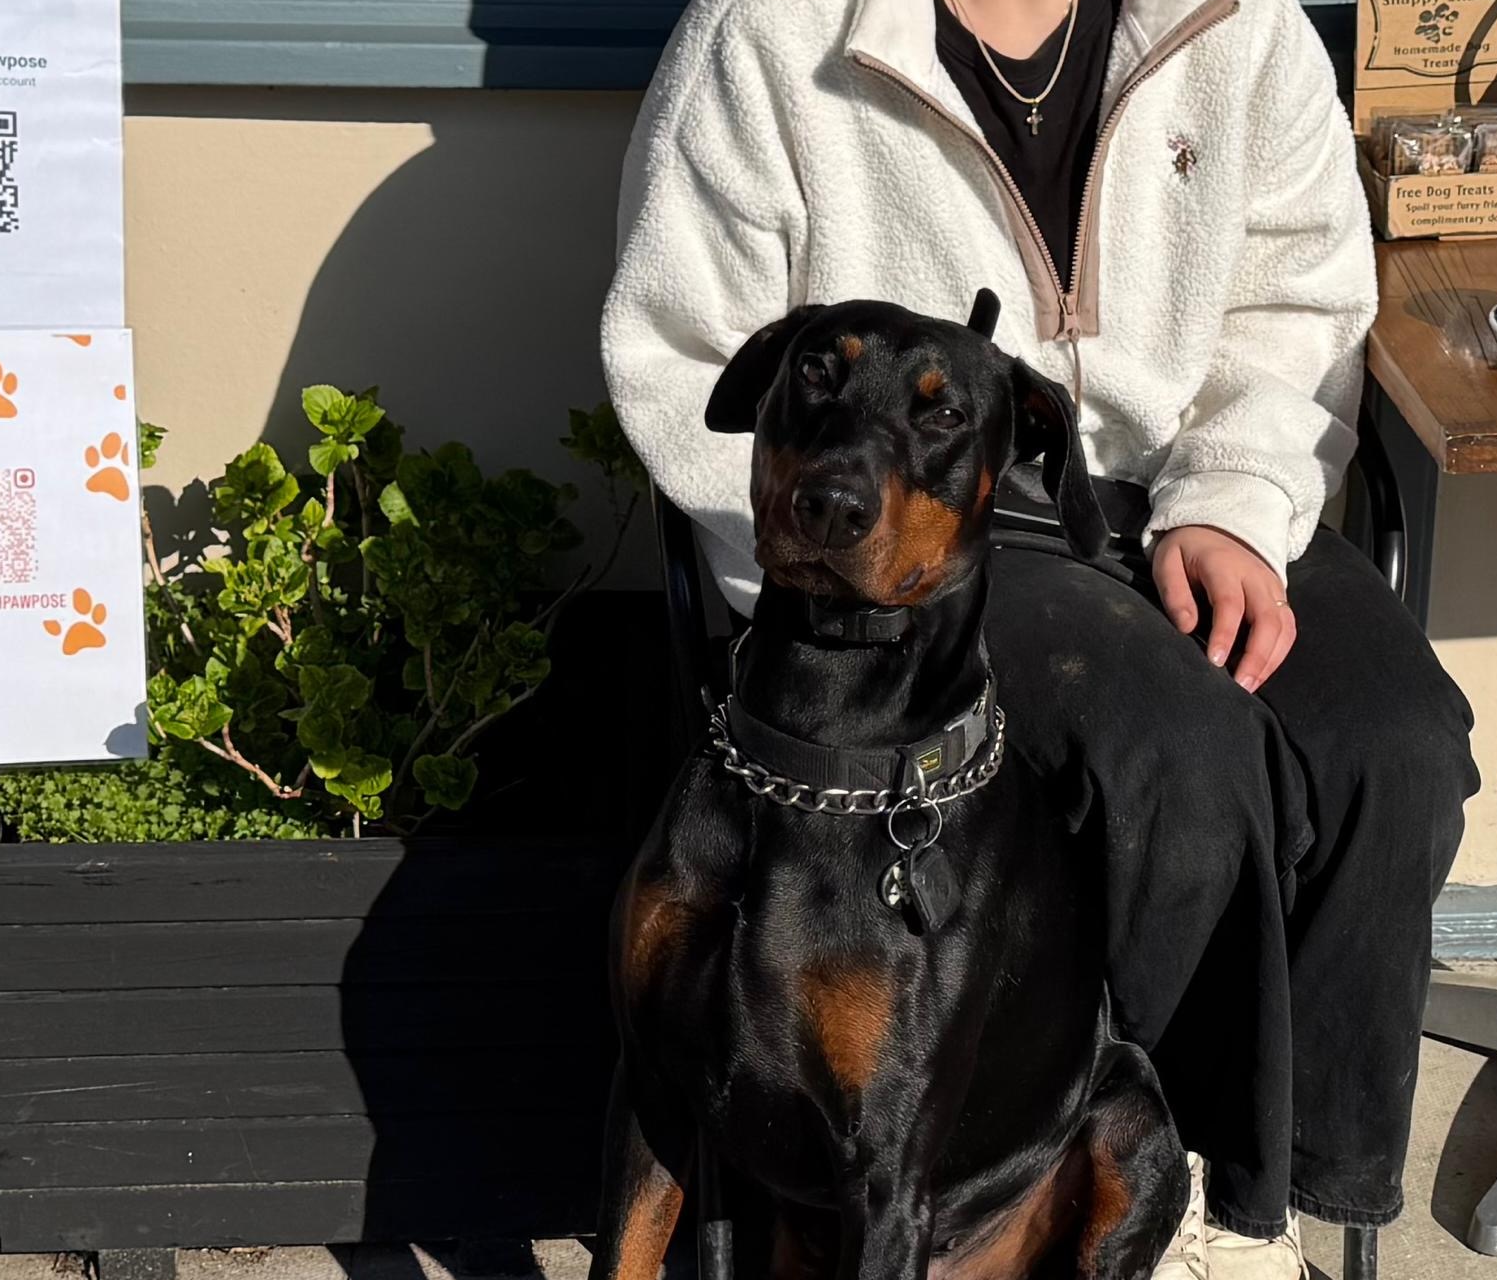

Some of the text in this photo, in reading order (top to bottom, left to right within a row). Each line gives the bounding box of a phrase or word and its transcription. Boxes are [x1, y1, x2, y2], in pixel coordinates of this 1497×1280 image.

[1393, 43, 1461, 56] Homemade
[1422, 58, 1461, 68] Treats
[1396, 185, 1422, 199] Free
[1426, 185, 1451, 199] Dog
[1456, 183, 1495, 197] Treats
[1406, 202, 1428, 213] Spoil
[1430, 203, 1454, 214] your
[1456, 201, 1480, 213] furry
[1411, 214, 1486, 227] complimentary
